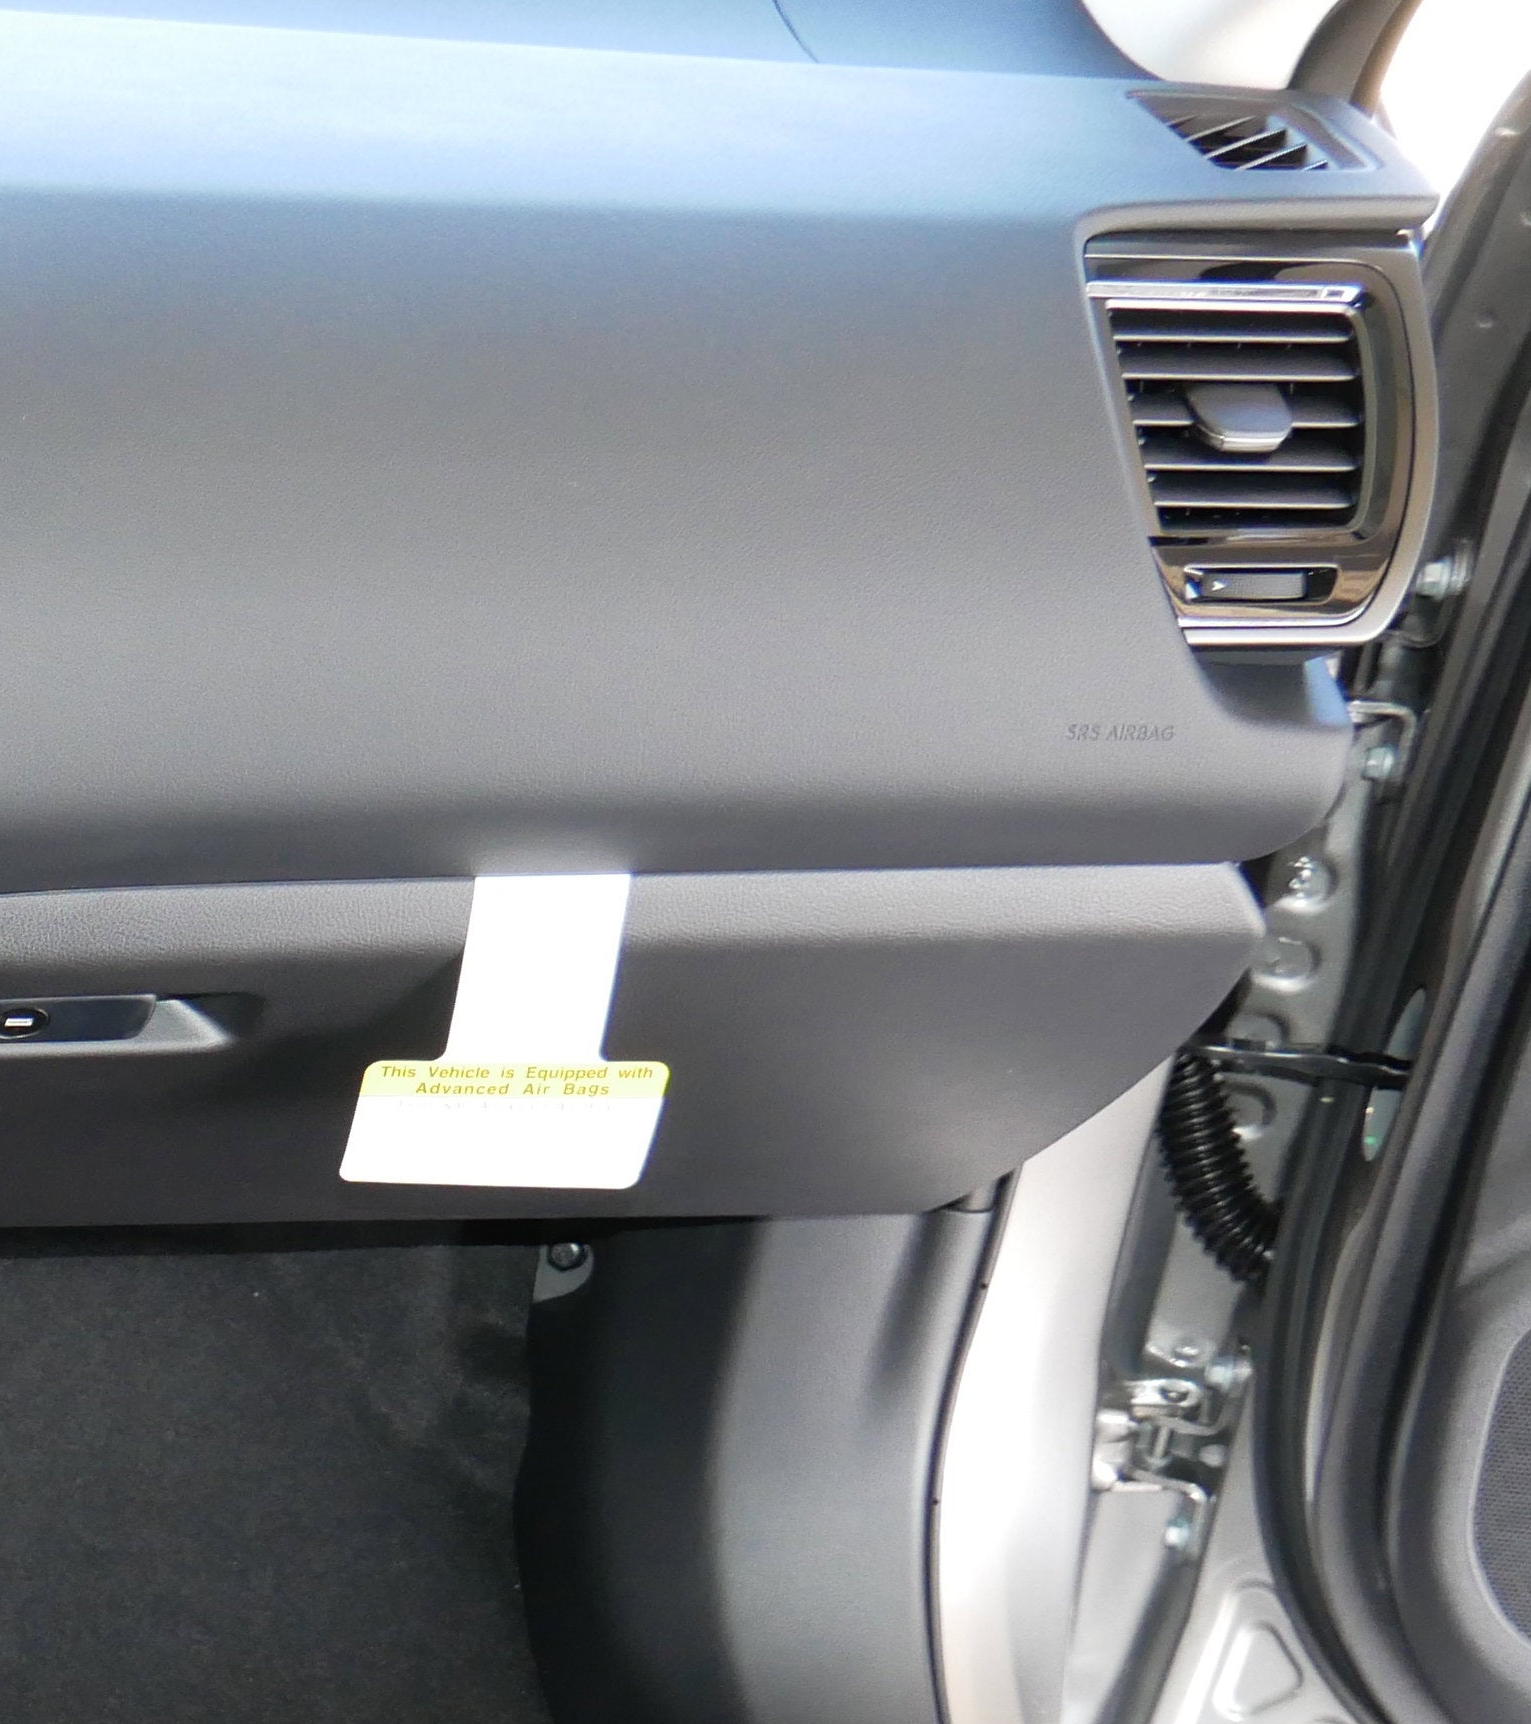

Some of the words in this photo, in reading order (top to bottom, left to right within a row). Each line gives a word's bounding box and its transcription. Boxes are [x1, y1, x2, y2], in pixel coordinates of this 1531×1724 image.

[1066, 723, 1101, 742] SRS
[1105, 723, 1175, 742] AIRBAG
[381, 1066, 417, 1079] This
[429, 1066, 490, 1079] Vehicle
[501, 1067, 514, 1079] is
[526, 1066, 608, 1082] Equipped
[618, 1066, 653, 1079] with
[416, 1080, 509, 1096] Advanced
[523, 1082, 550, 1096] Air
[563, 1082, 610, 1098] Bags
